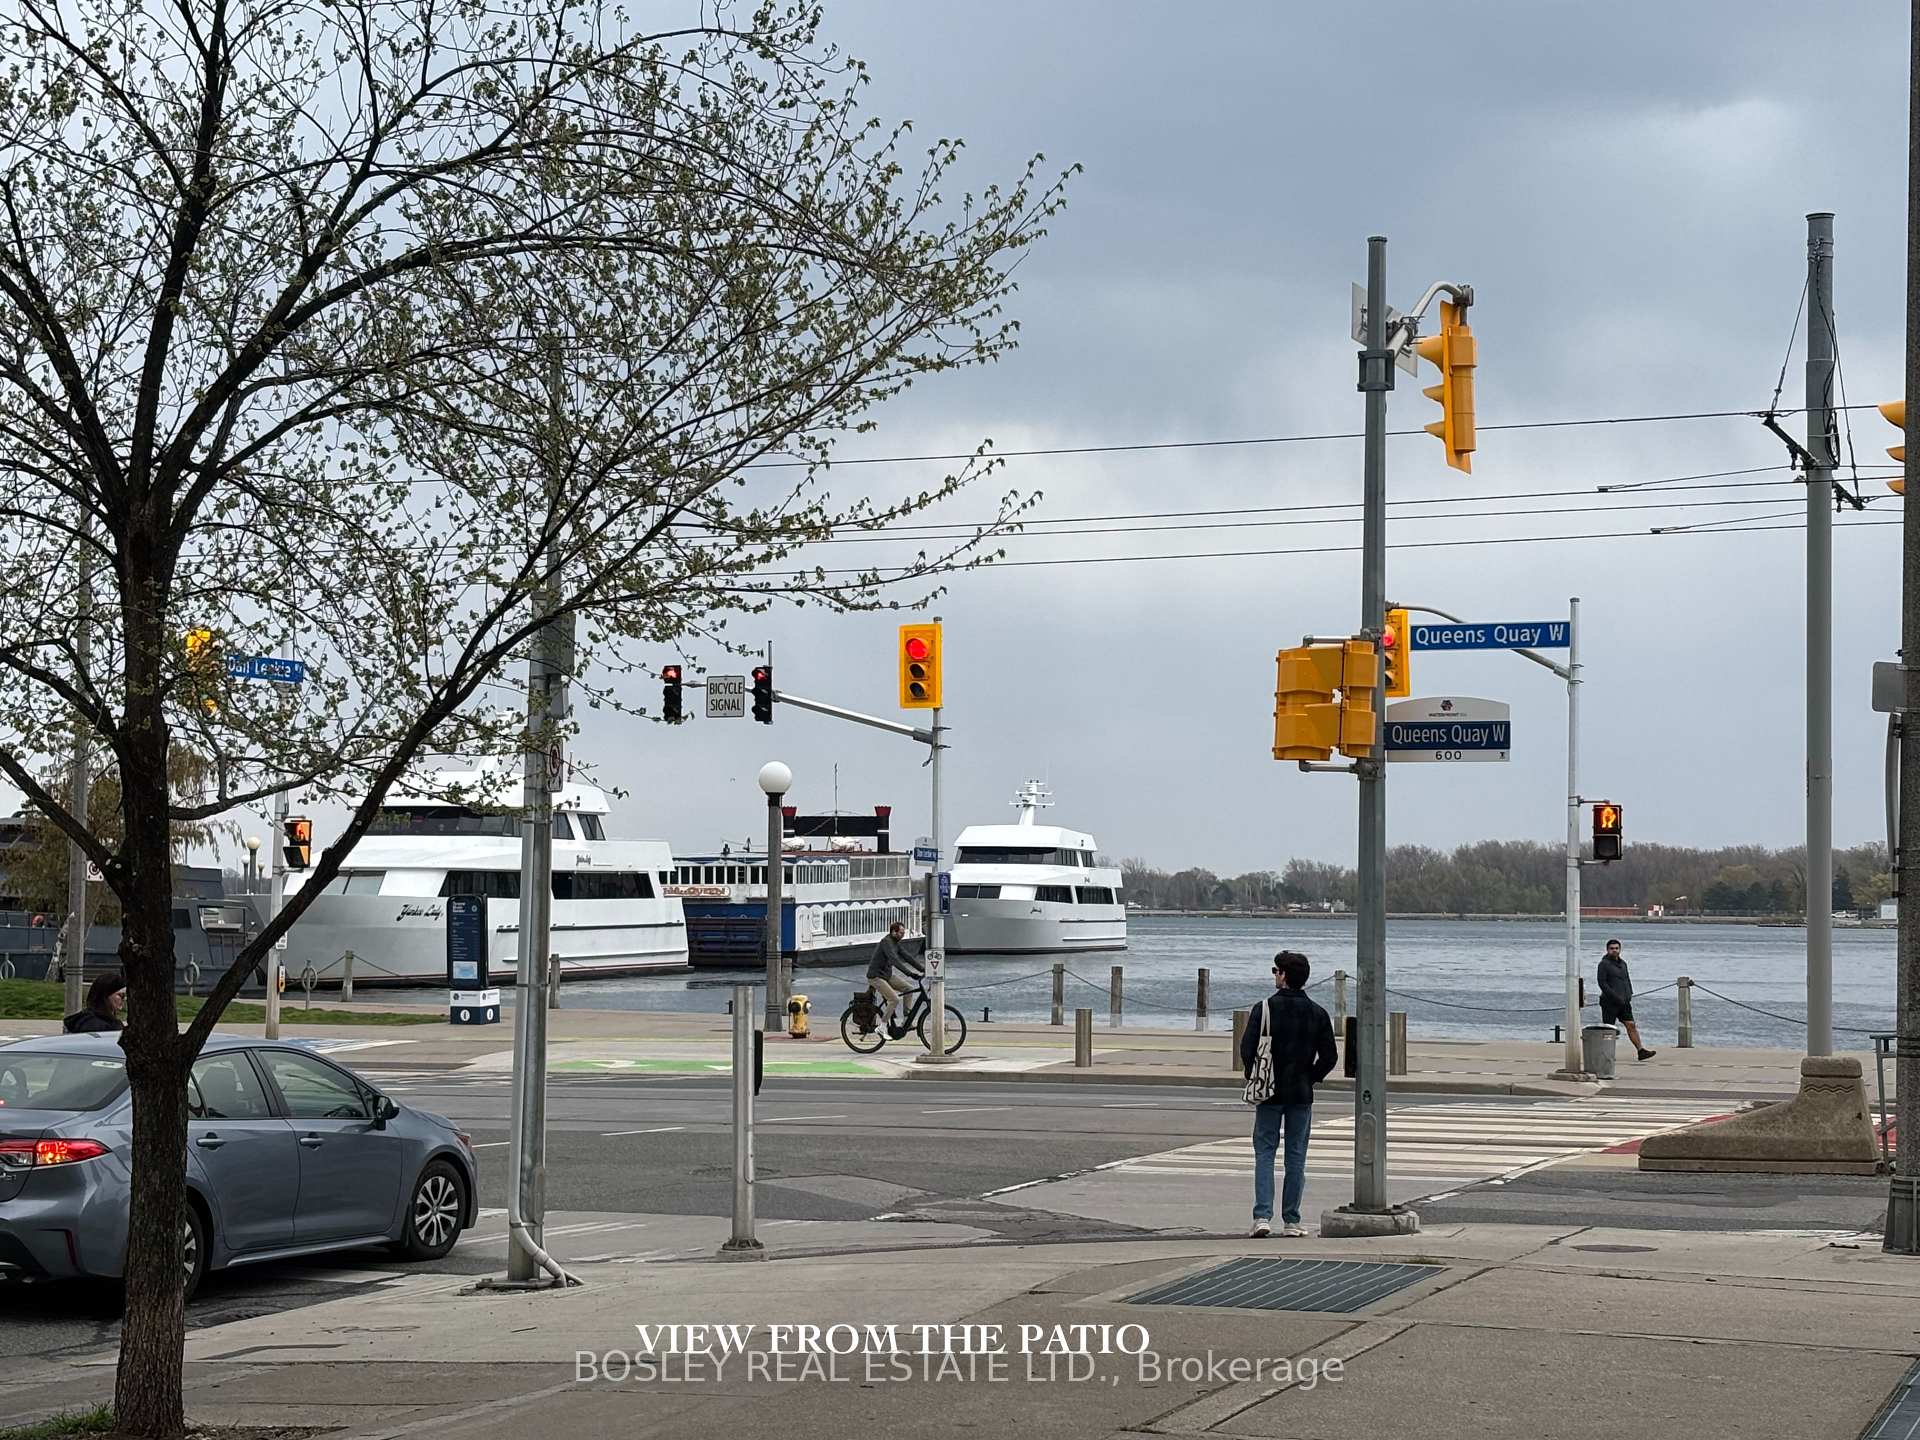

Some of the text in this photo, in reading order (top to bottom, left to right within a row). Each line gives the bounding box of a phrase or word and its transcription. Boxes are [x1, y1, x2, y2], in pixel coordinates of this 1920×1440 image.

[1416, 624, 1564, 645] Queens Quay W
[710, 682, 743, 694] BICYCLE
[711, 699, 741, 711] SIGNAL
[1392, 724, 1505, 747] Queens Quay W
[1436, 751, 1462, 760] 600
